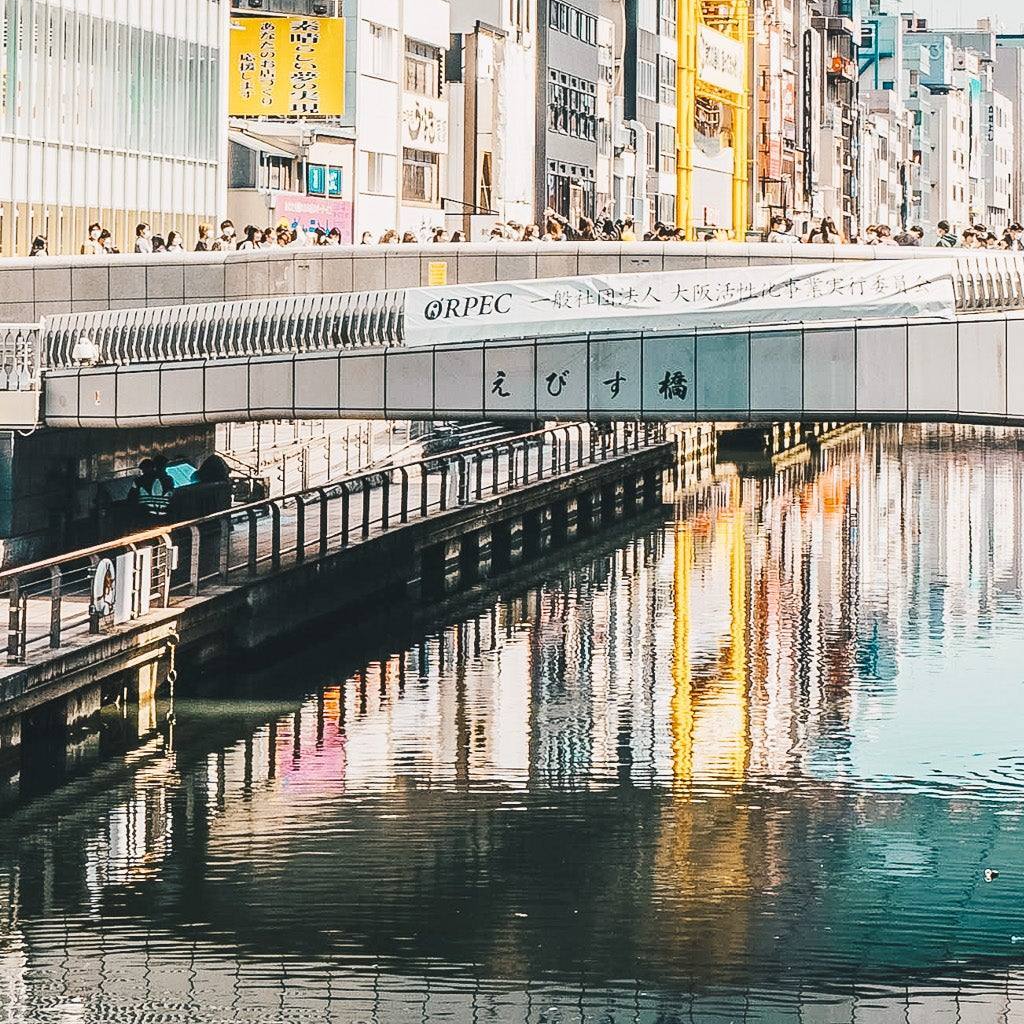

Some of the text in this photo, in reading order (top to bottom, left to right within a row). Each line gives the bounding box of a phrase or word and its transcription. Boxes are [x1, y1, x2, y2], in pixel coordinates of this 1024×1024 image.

[531, 288, 661, 309] 一般社団法人
[491, 370, 689, 400] えびす橋
